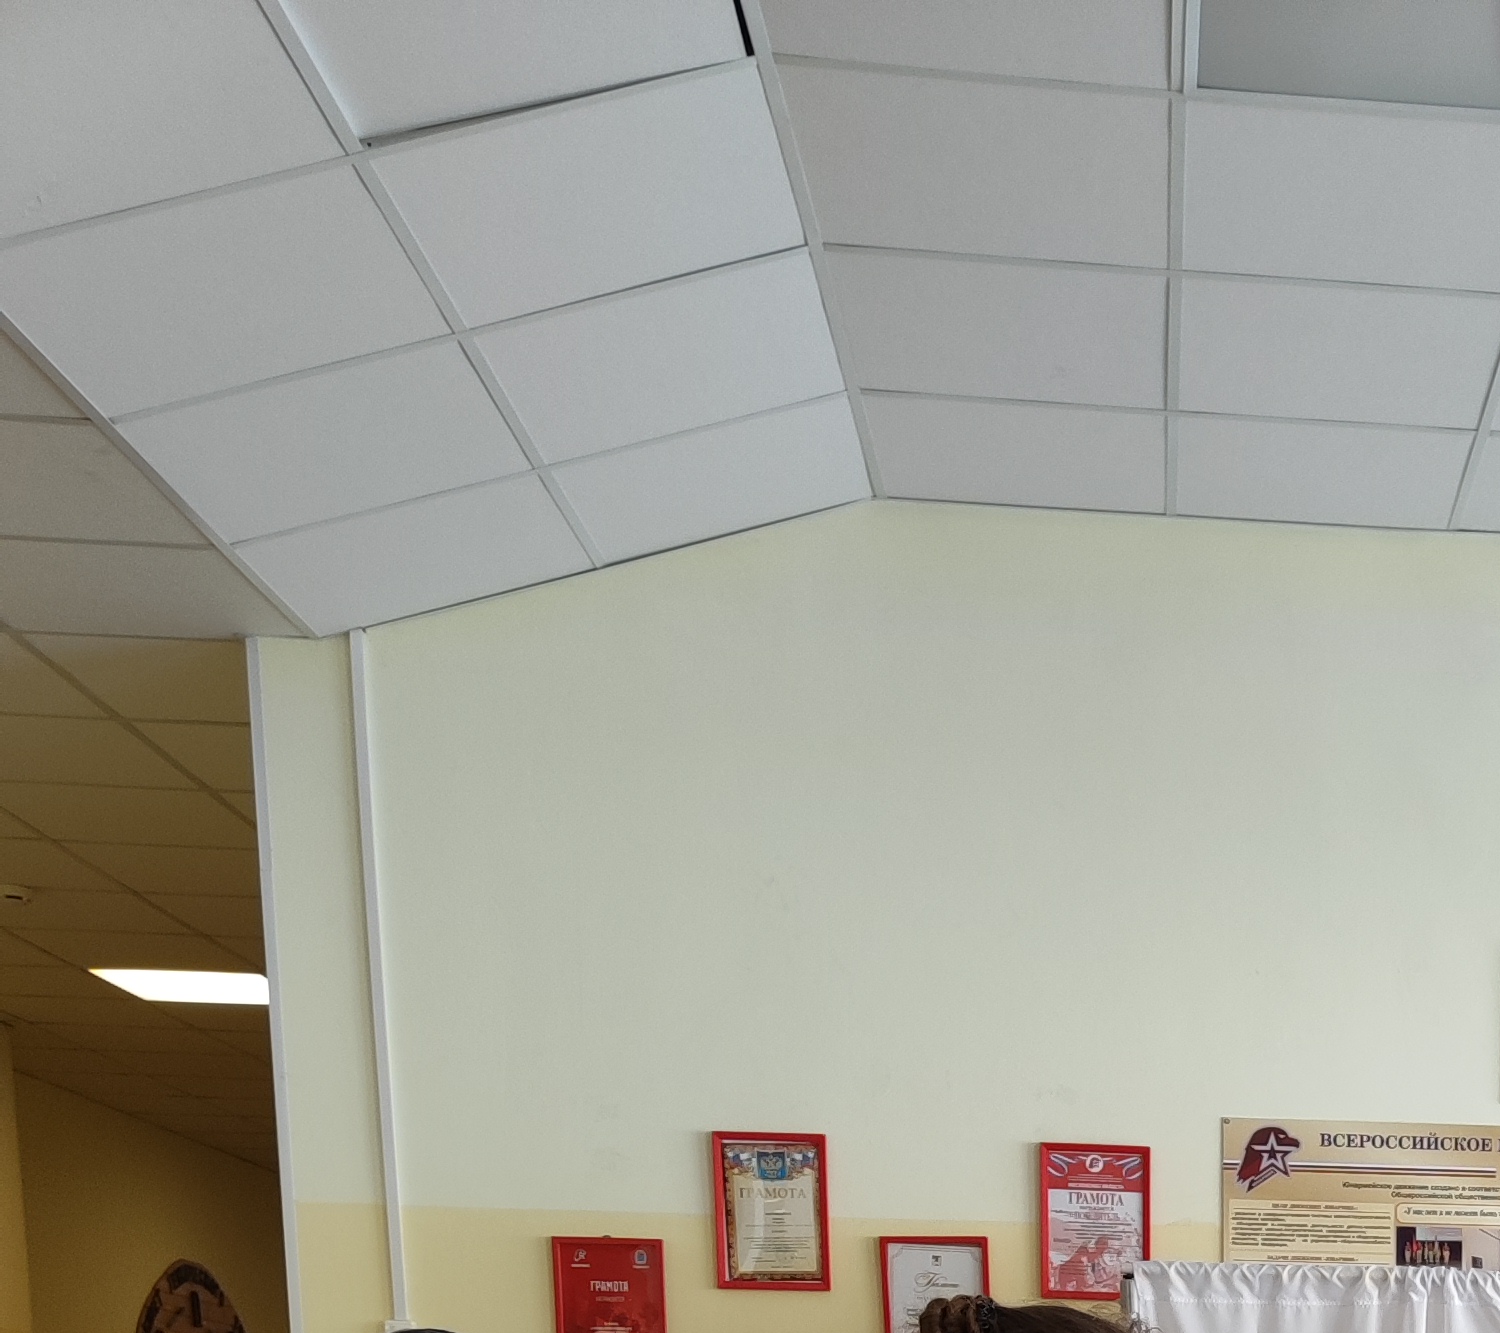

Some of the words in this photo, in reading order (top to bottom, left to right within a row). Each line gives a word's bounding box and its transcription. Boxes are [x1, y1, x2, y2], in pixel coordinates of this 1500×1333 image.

[1319, 1131, 1493, 1152] ВСЕРОССИЙСКОЕ
[739, 1187, 807, 1199] ГРАМОТА
[1068, 1191, 1125, 1206] ГРАМОТА
